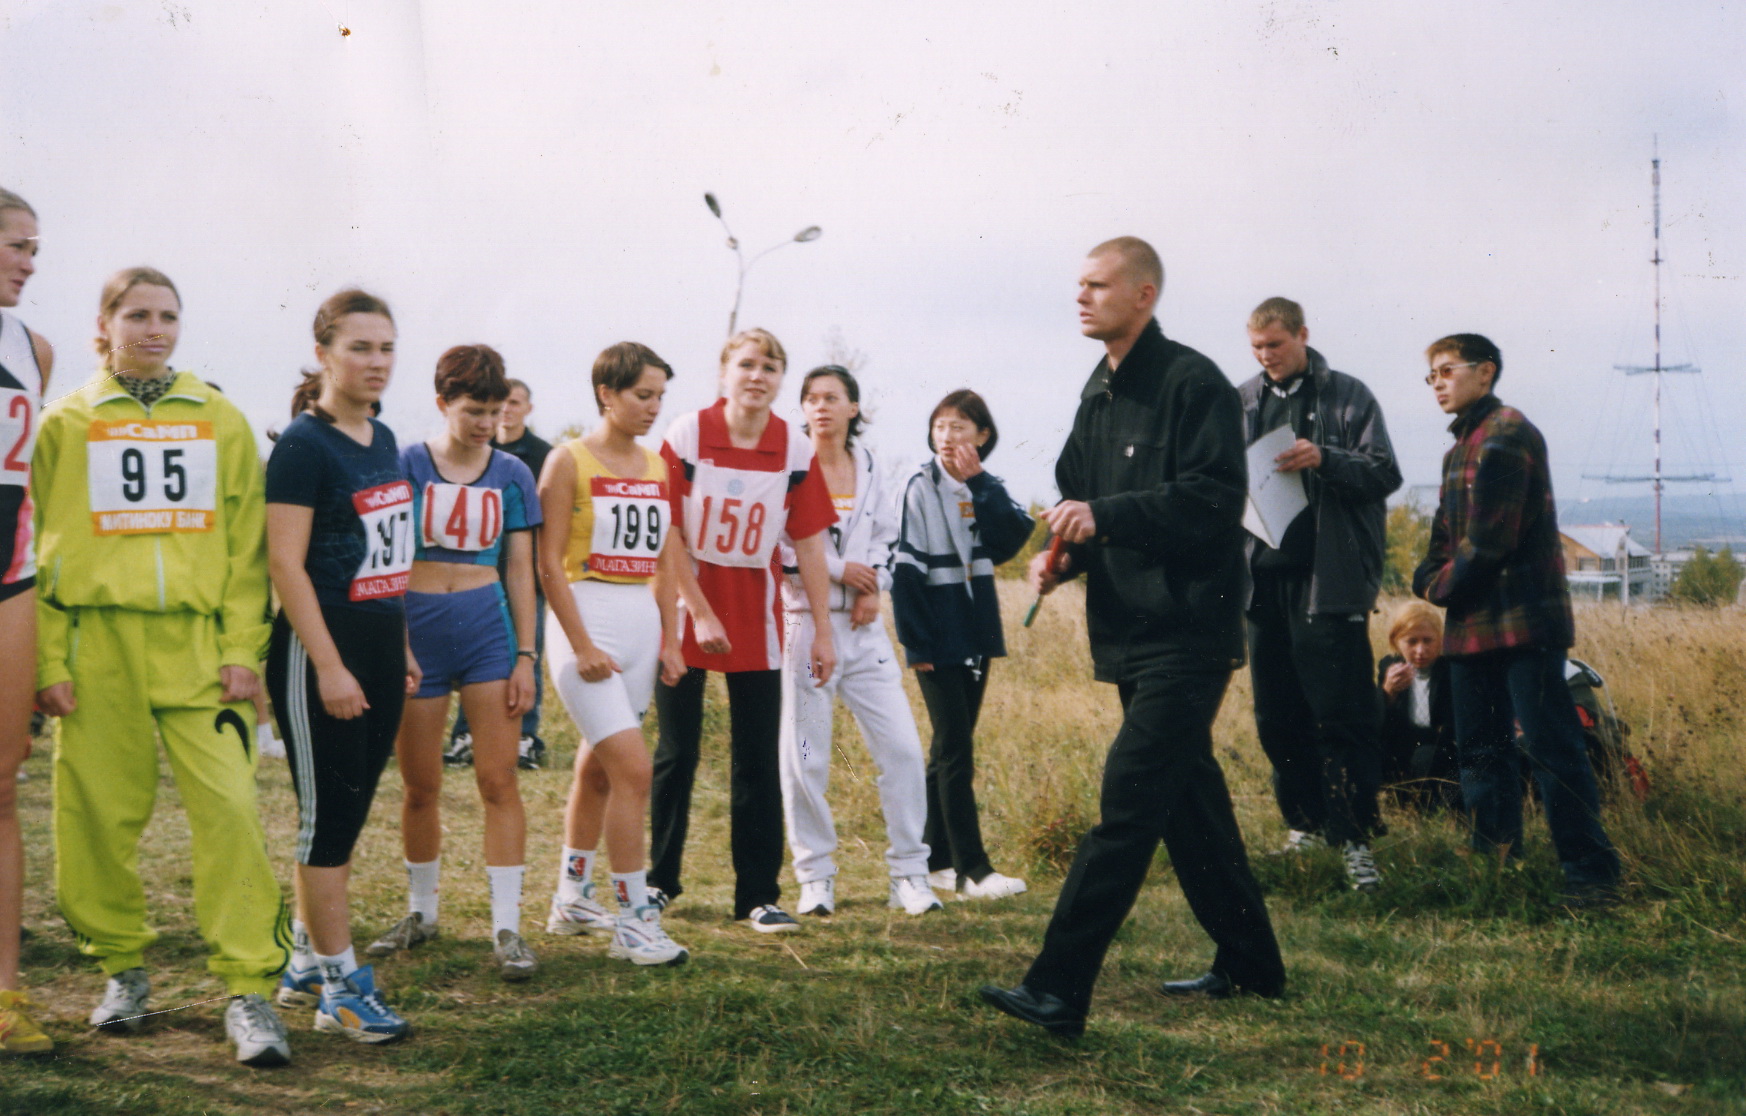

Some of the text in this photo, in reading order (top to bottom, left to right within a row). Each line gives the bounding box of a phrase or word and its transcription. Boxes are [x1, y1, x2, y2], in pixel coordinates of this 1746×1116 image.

[4, 395, 32, 472] 2
[121, 447, 187, 503] 95
[423, 483, 501, 549] 140
[611, 503, 661, 551] 199
[697, 495, 766, 556] 158
